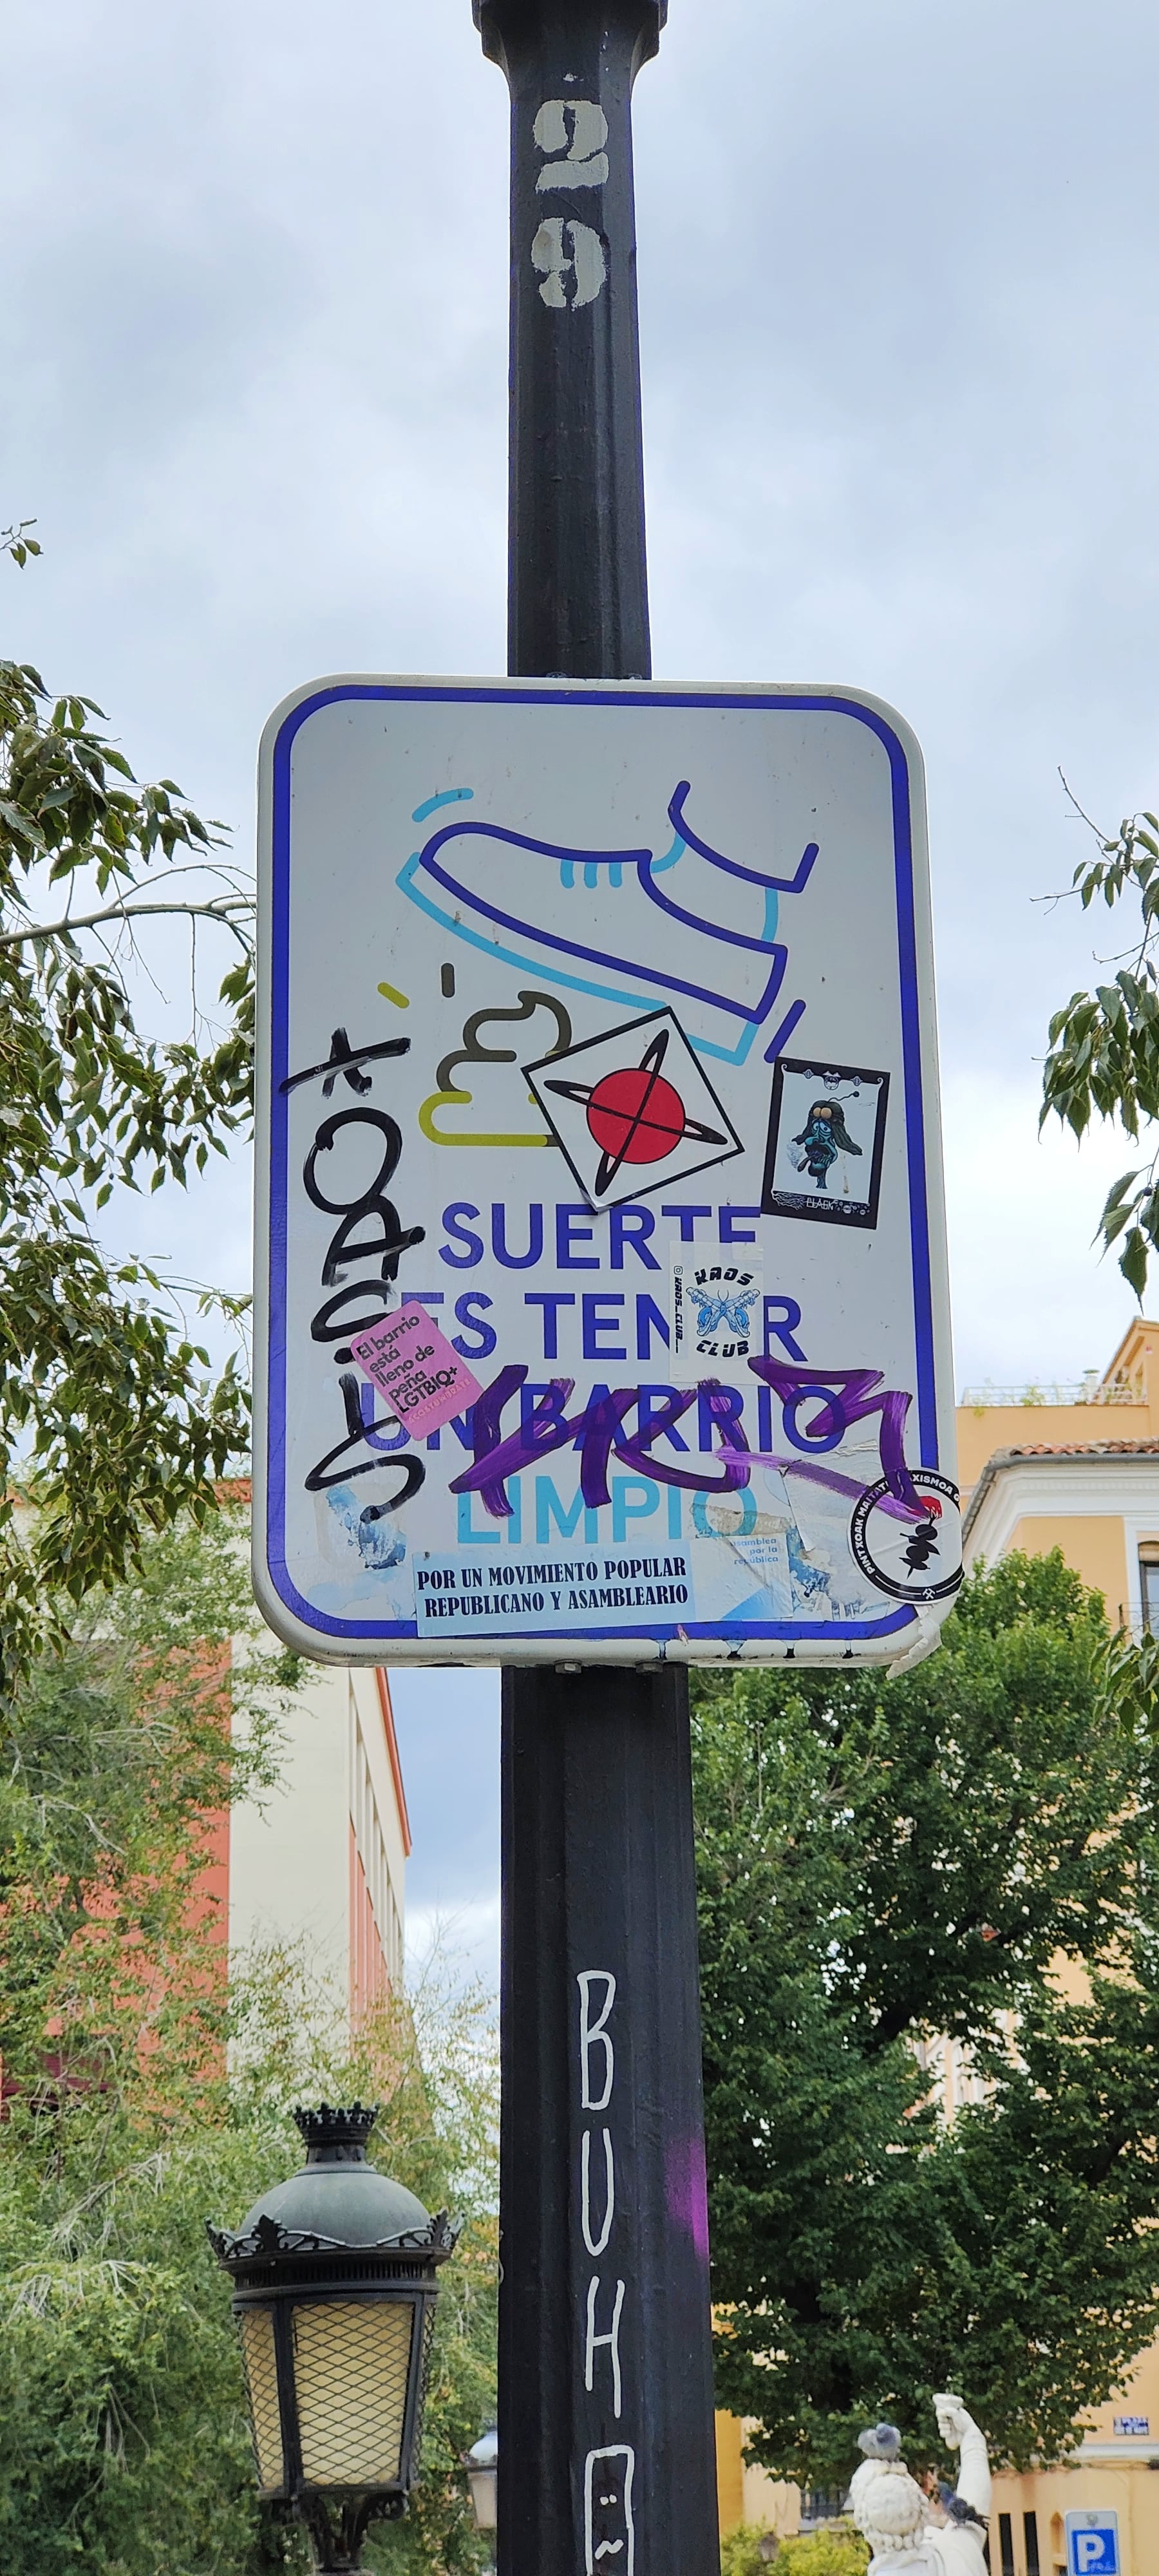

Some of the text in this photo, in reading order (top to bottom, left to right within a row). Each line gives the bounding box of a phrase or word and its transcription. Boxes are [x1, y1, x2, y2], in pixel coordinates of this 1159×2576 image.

[438, 1202, 761, 1270] SUERTE
[694, 1266, 755, 1286] KAOS
[355, 1316, 420, 1360] El barrio
[524, 1293, 808, 1361] TENR
[370, 1345, 401, 1373] está
[375, 1345, 435, 1387] lleno de
[696, 1340, 749, 1358] CLUB
[388, 1370, 428, 1401] peña
[393, 1367, 458, 1414] LGTBIQ+
[520, 1383, 845, 1454] BARRIO
[458, 1475, 757, 1544] LIMPIO
[855, 1517, 875, 1575] PINTXOAK
[417, 1557, 687, 1591] POR UN MOVIMIENTO POPULAR
[424, 1584, 689, 1618] REPUBLICANO Y ASAMBLEARIO
[1077, 2534, 1105, 2572] P
